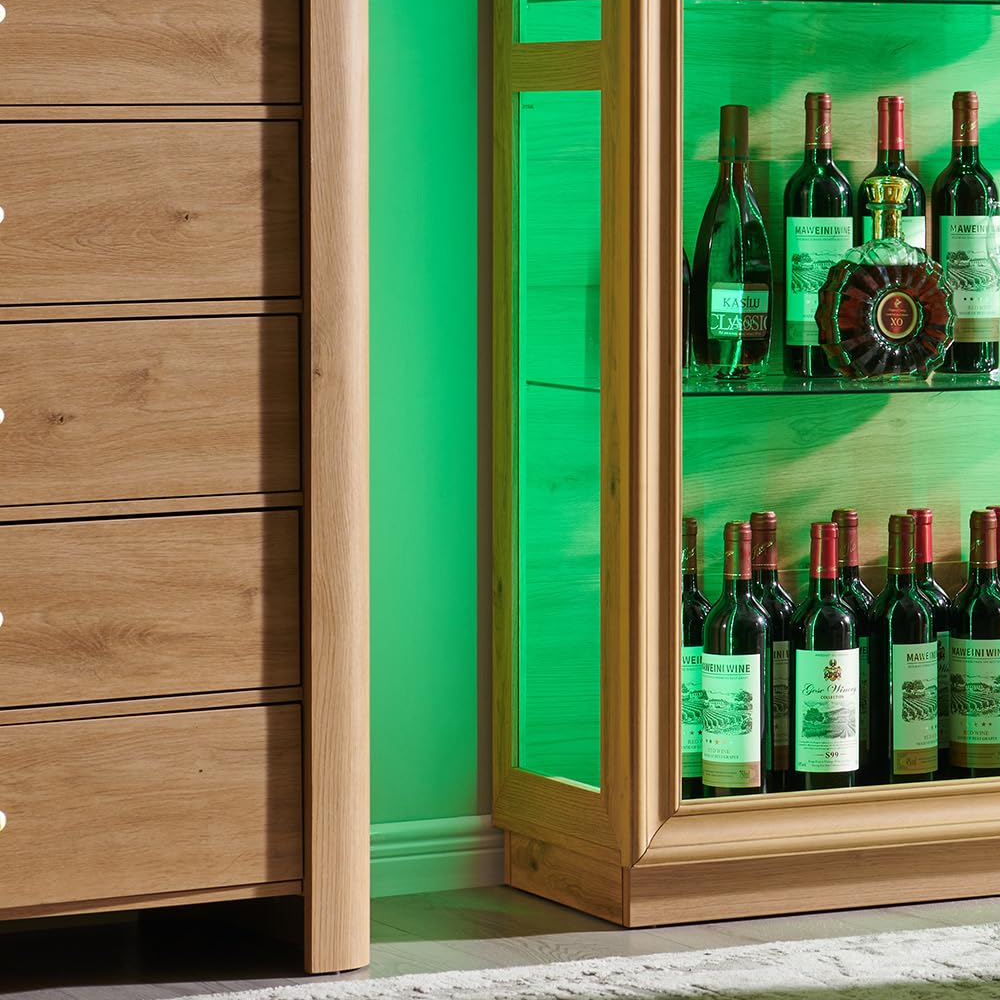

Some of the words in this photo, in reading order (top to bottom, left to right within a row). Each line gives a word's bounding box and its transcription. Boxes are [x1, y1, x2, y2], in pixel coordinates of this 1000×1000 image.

[795, 226, 833, 235] MAWEINI
[834, 226, 851, 235] WINE
[890, 317, 903, 327] XO
[951, 648, 985, 657] MAWEINI
[726, 664, 750, 673] WINE
[825, 751, 839, 759] S99
